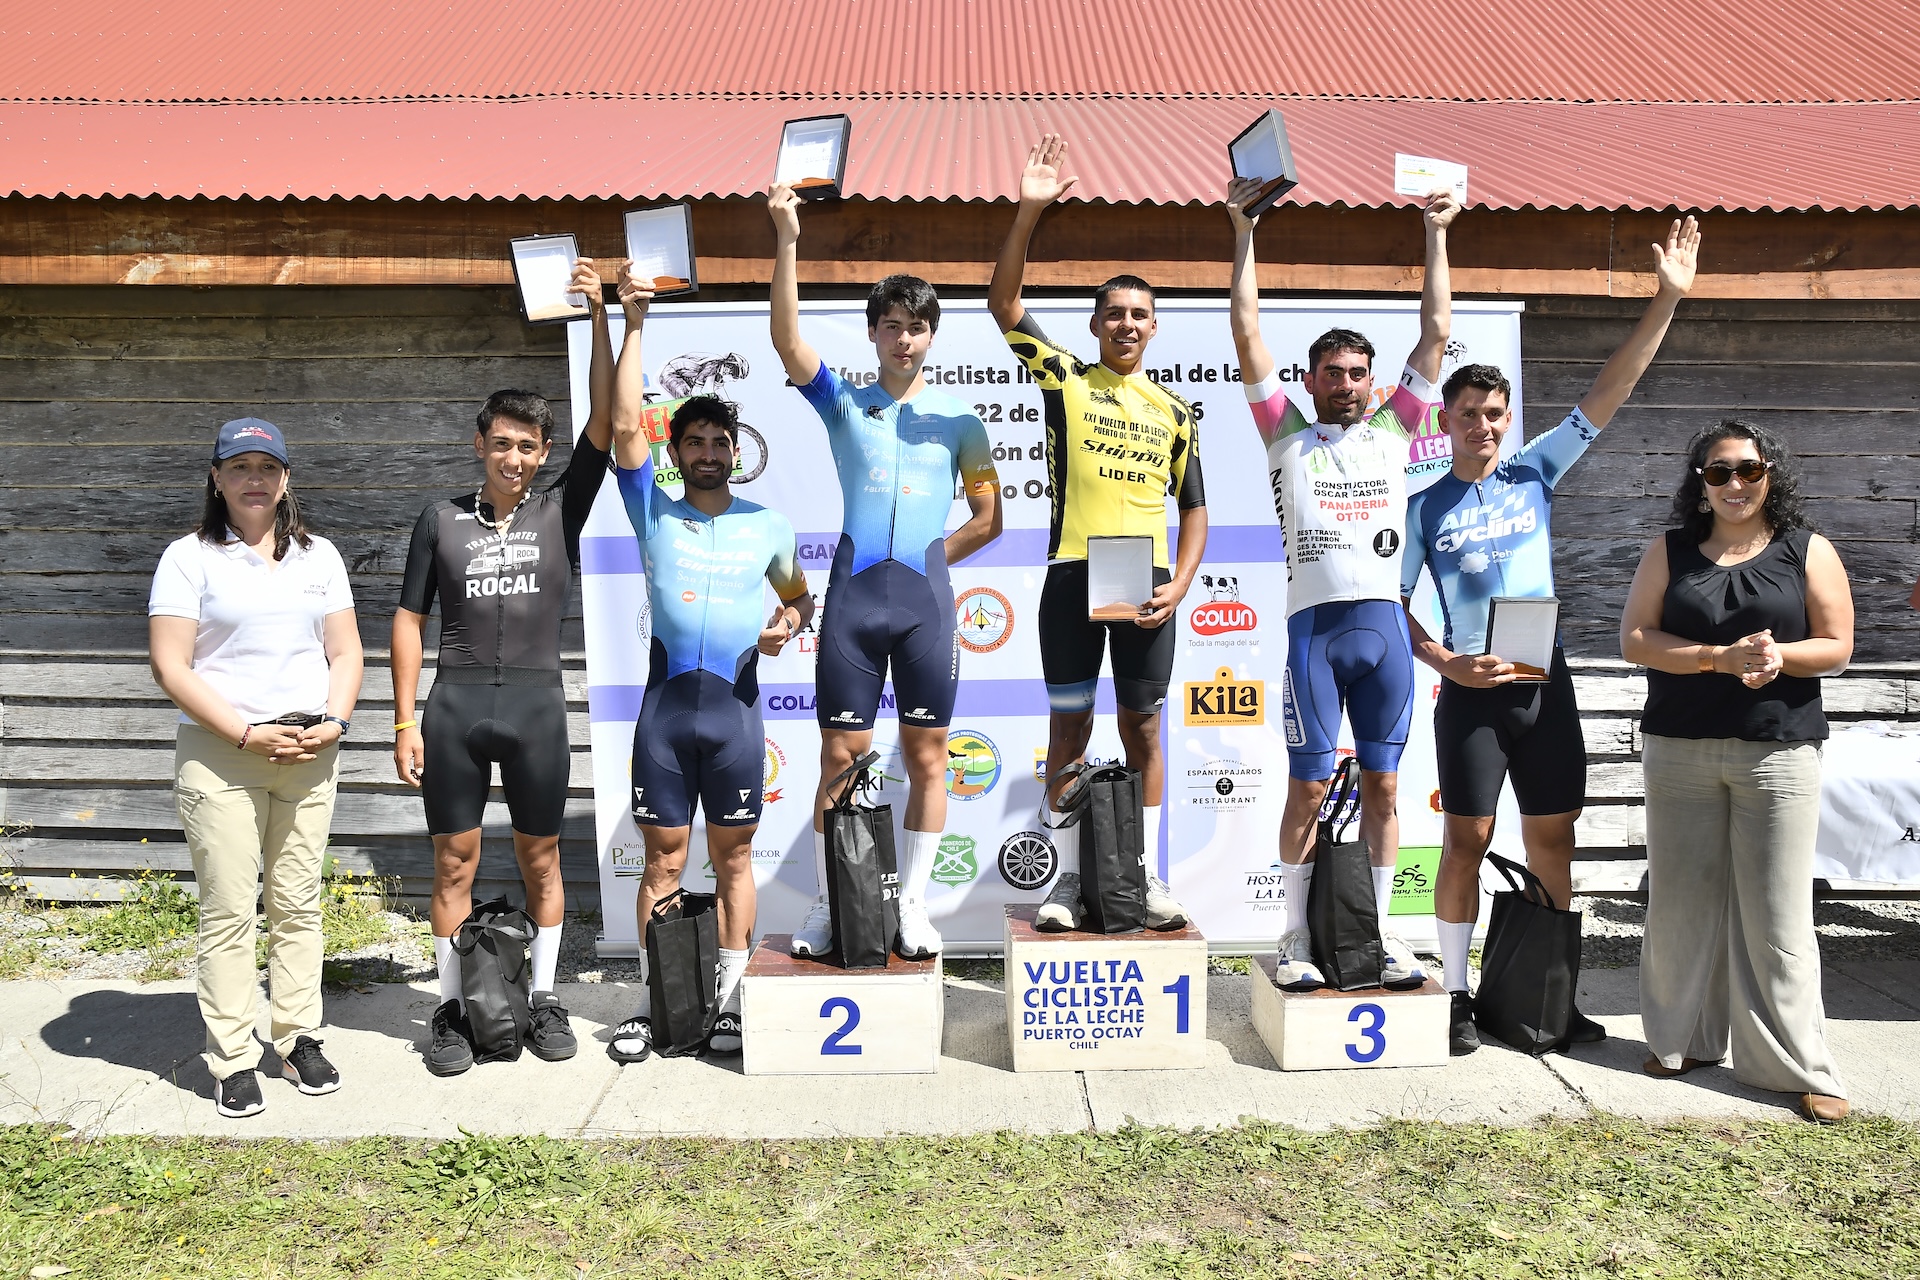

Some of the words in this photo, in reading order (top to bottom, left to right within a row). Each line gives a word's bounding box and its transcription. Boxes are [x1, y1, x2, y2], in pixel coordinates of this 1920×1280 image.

[1188, 364, 1219, 383] de
[1017, 403, 1039, 423] de
[1084, 412, 1097, 424] XXI
[1099, 415, 1126, 430] VUELTA
[1130, 422, 1139, 432] DE
[1141, 424, 1150, 434] LA
[1151, 425, 1169, 441] LECHE
[1093, 425, 1118, 439] PUERTO
[1146, 436, 1161, 446] CHILE
[991, 441, 1022, 461] ón
[1080, 439, 1164, 467] Skippy
[1099, 466, 1147, 484] LIDER
[1314, 489, 1348, 499] OSCAR
[1352, 487, 1389, 497] CASTRO
[1319, 498, 1389, 511] PANADERIA
[1336, 511, 1369, 522] OTTO
[1435, 506, 1537, 553] cycling
[516, 549, 536, 558] ROCAL
[1297, 549, 1325, 557] MARCHA
[675, 557, 749, 575] GIANT
[1298, 556, 1320, 565] SERGA
[676, 569, 697, 584] San
[465, 573, 541, 599] ROCAL
[961, 640, 985, 652] PUERTO
[985, 640, 1004, 652] OCTAY
[1188, 639, 1206, 648] Toda
[1206, 639, 1214, 647] la
[1215, 639, 1236, 650] magia
[1237, 638, 1248, 647] del
[1249, 639, 1260, 647] sur
[829, 716, 864, 724] SUNCKEL
[903, 712, 937, 721] SUNCKEL
[765, 737, 787, 767] MBEROS
[1187, 768, 1262, 776] ESPANTAPAJAROS
[947, 791, 966, 801] CONAF
[970, 790, 986, 800] CHILE
[1192, 796, 1257, 805] RESTAURANT
[1255, 889, 1273, 899] LA
[1391, 887, 1411, 895] ippy
[1252, 903, 1281, 912] Puerto
[1024, 960, 1144, 985] VUELTA
[1023, 986, 1144, 1008] CICLISTA
[1162, 974, 1190, 1034] 1
[1024, 1011, 1047, 1025] DE
[1055, 1010, 1079, 1025] LA
[1087, 1009, 1145, 1024] LECHE
[819, 996, 862, 1056] 2
[1344, 1002, 1386, 1064] 3
[1024, 1028, 1086, 1041] PUERTO
[1092, 1027, 1144, 1039] OCTAY
[1069, 1041, 1099, 1050] CHILE
